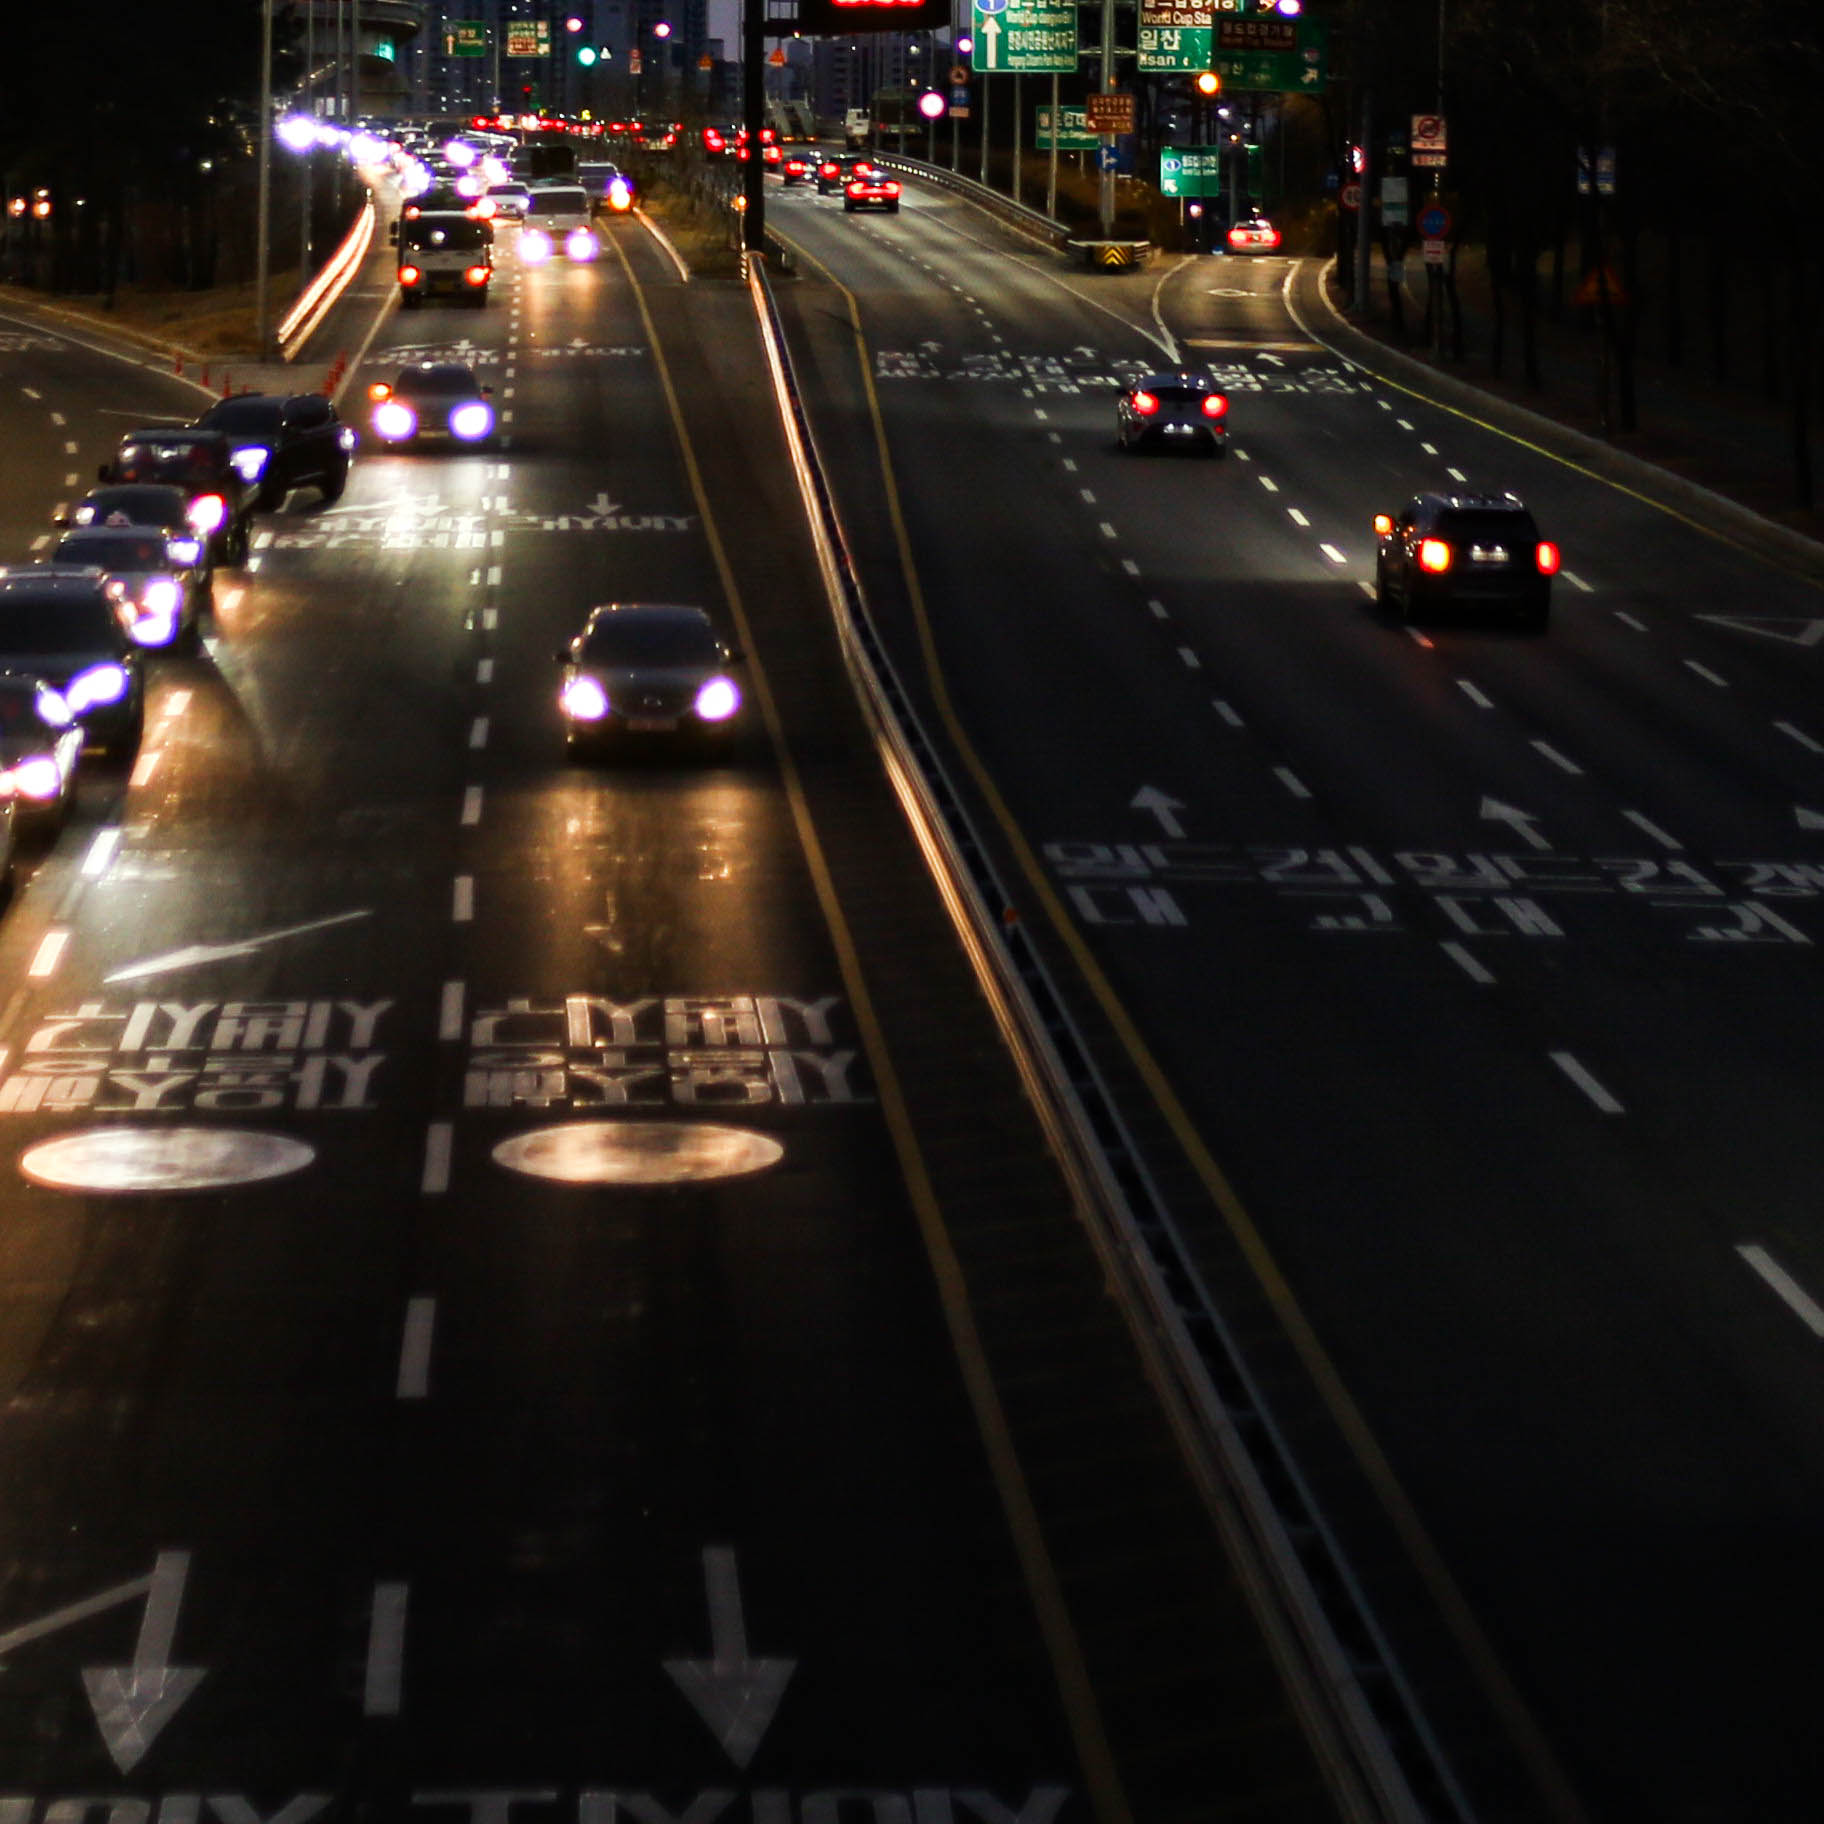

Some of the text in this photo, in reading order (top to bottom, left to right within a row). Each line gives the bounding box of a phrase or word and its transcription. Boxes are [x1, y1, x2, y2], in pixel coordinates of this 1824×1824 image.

[1140, 29, 1181, 51] 일산
[1142, 10, 1212, 29] World Cup Sta
[24, 999, 396, 1054] 시범지구
[470, 996, 844, 1048] 시범지구
[463, 1048, 878, 1107] 자율주행
